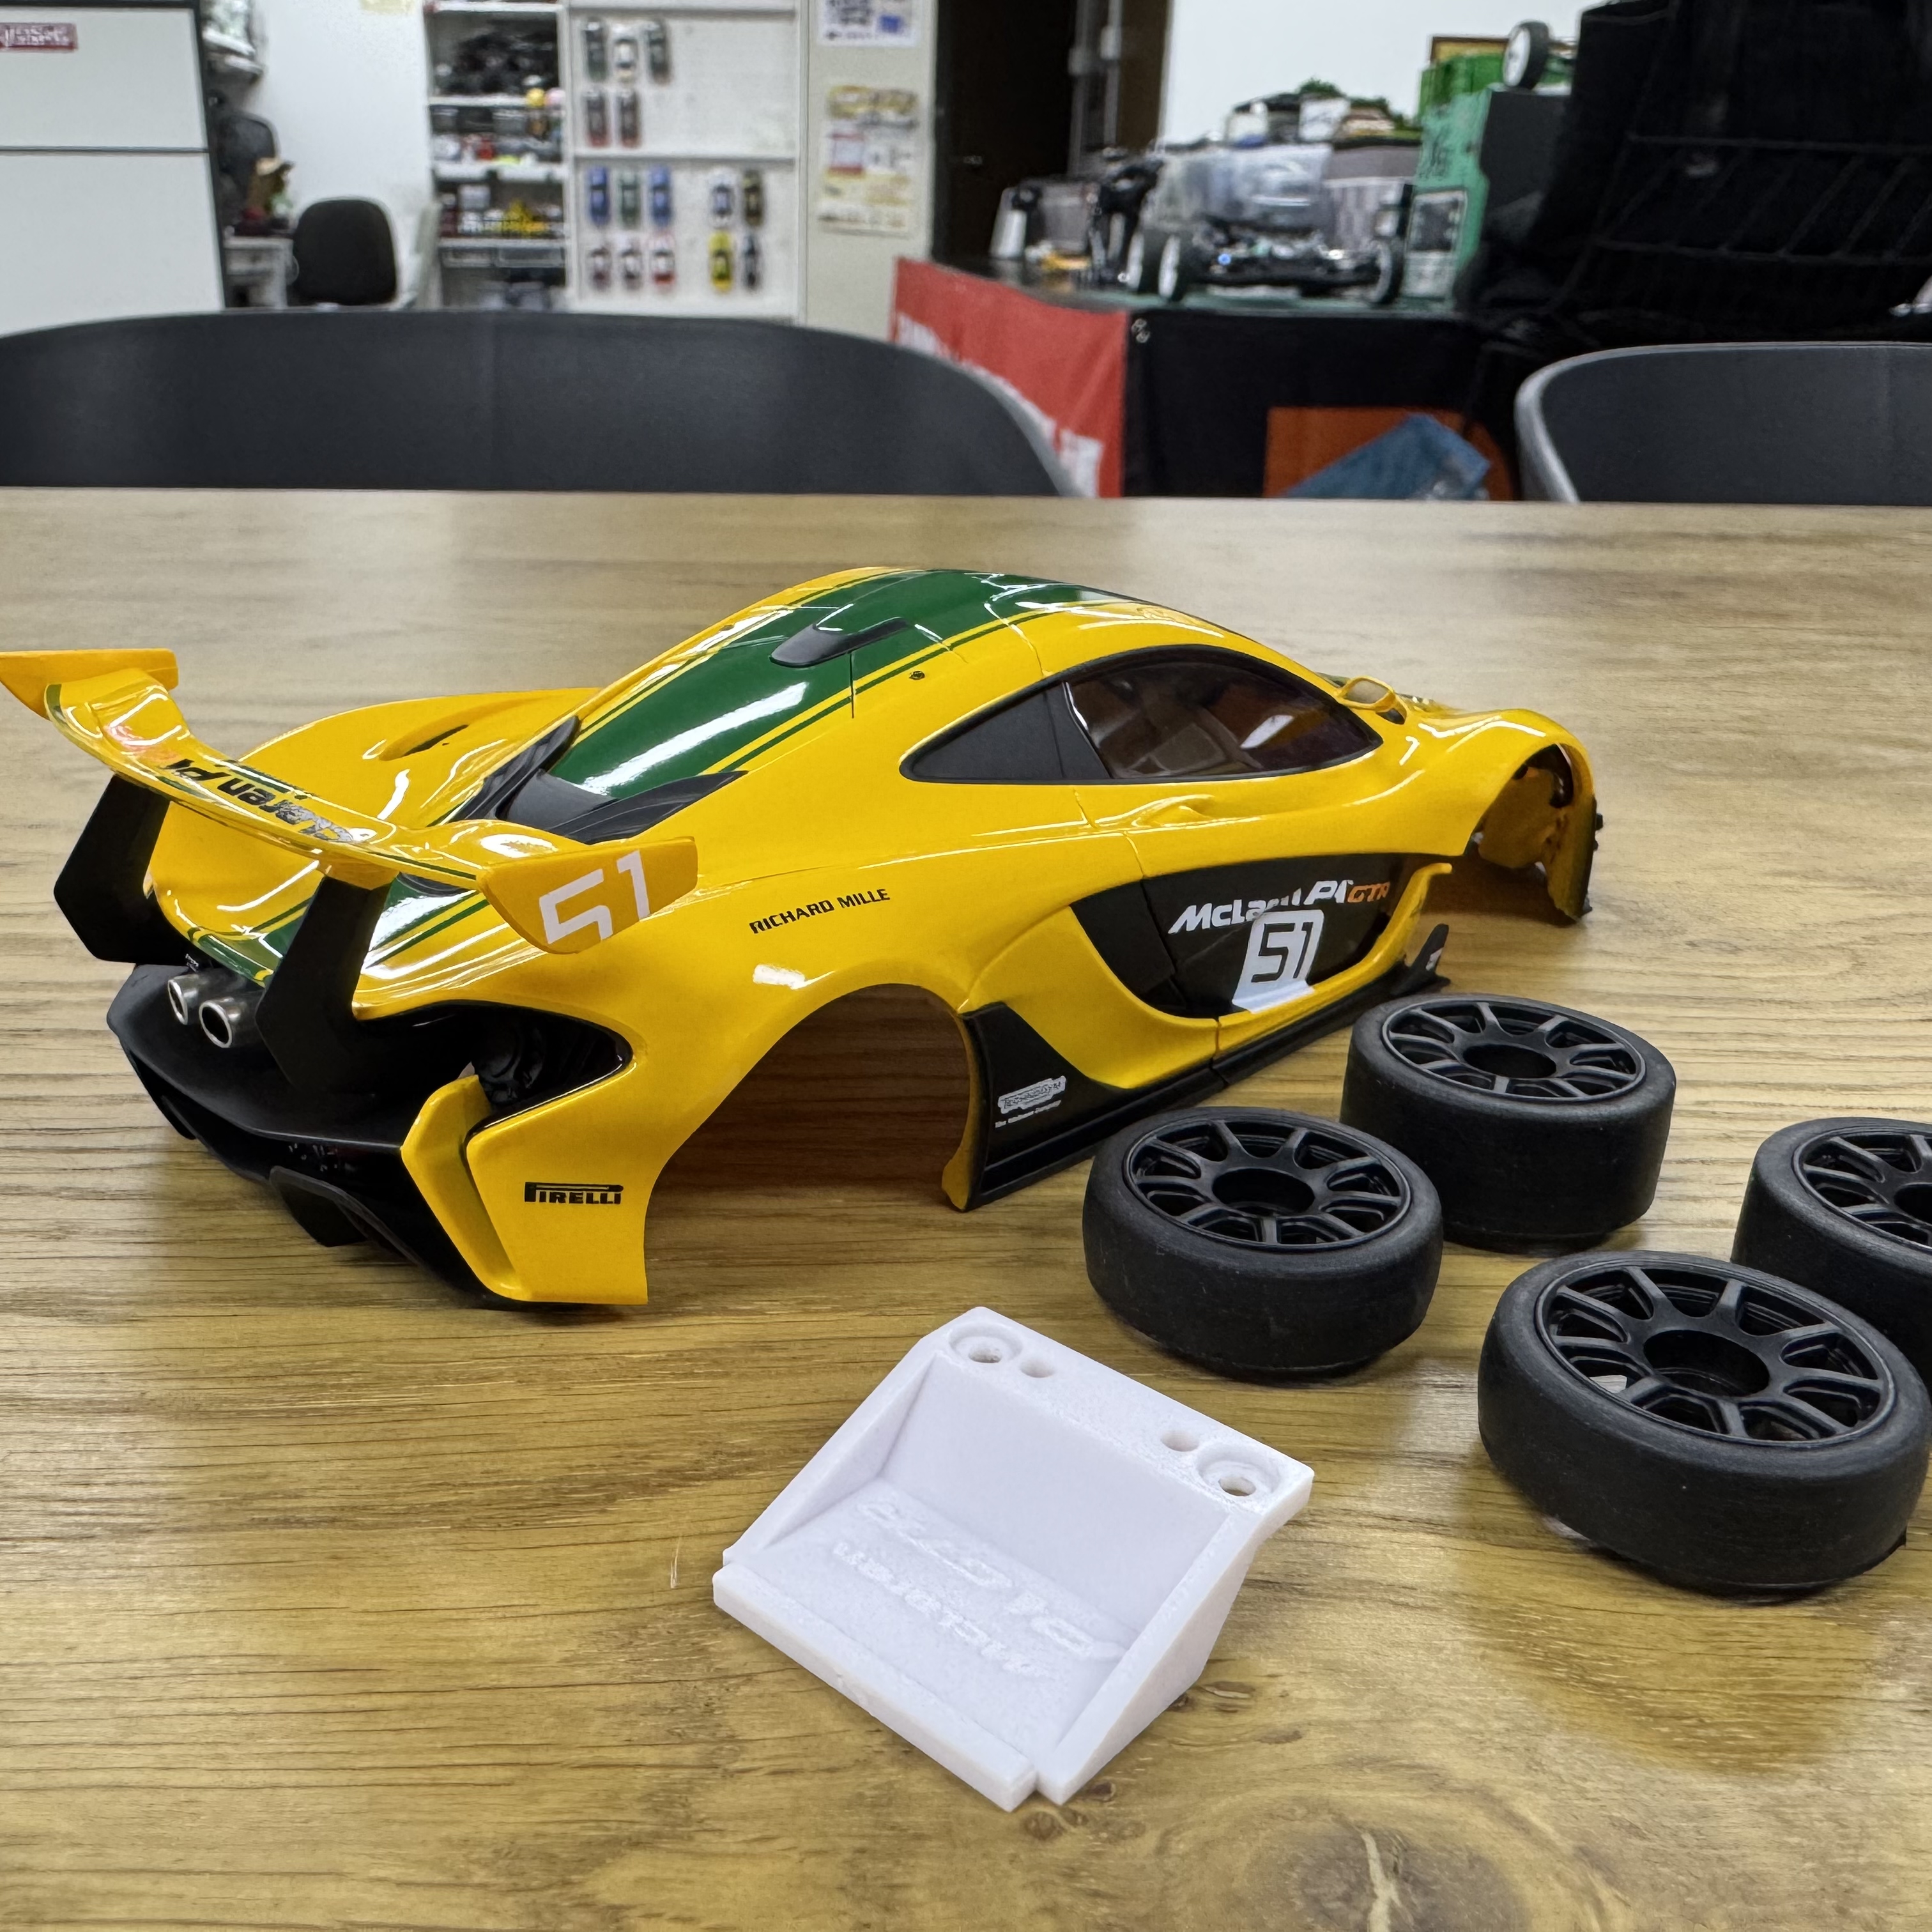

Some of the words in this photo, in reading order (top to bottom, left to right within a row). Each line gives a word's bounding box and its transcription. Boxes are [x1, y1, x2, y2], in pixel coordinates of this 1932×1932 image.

[539, 850, 650, 944] 51
[749, 900, 835, 934] RICHARD
[836, 889, 891, 909] MILLE
[1303, 879, 1354, 905] P1
[1250, 921, 1314, 983] 51
[525, 1181, 624, 1204] PIRELLI
